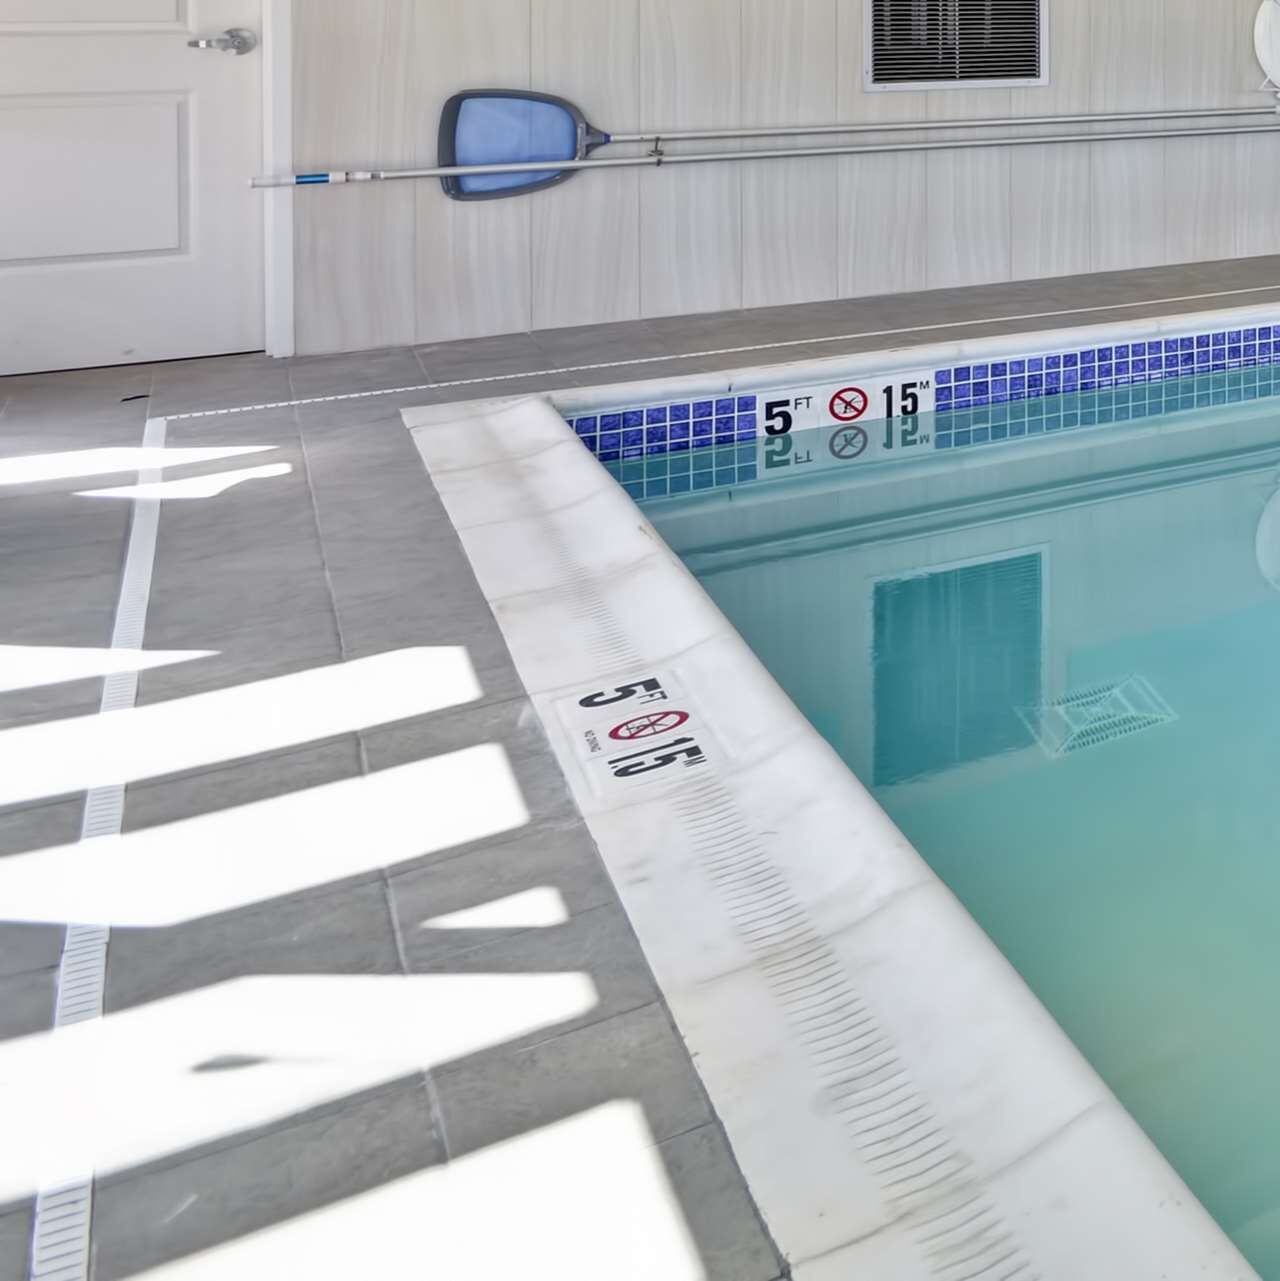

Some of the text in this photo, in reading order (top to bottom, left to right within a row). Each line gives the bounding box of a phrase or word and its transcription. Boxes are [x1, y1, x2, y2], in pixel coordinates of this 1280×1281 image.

[764, 399, 793, 436] 5
[794, 396, 813, 410] FT
[919, 379, 930, 390] M
[578, 677, 662, 708] 5
[637, 690, 668, 705] FT
